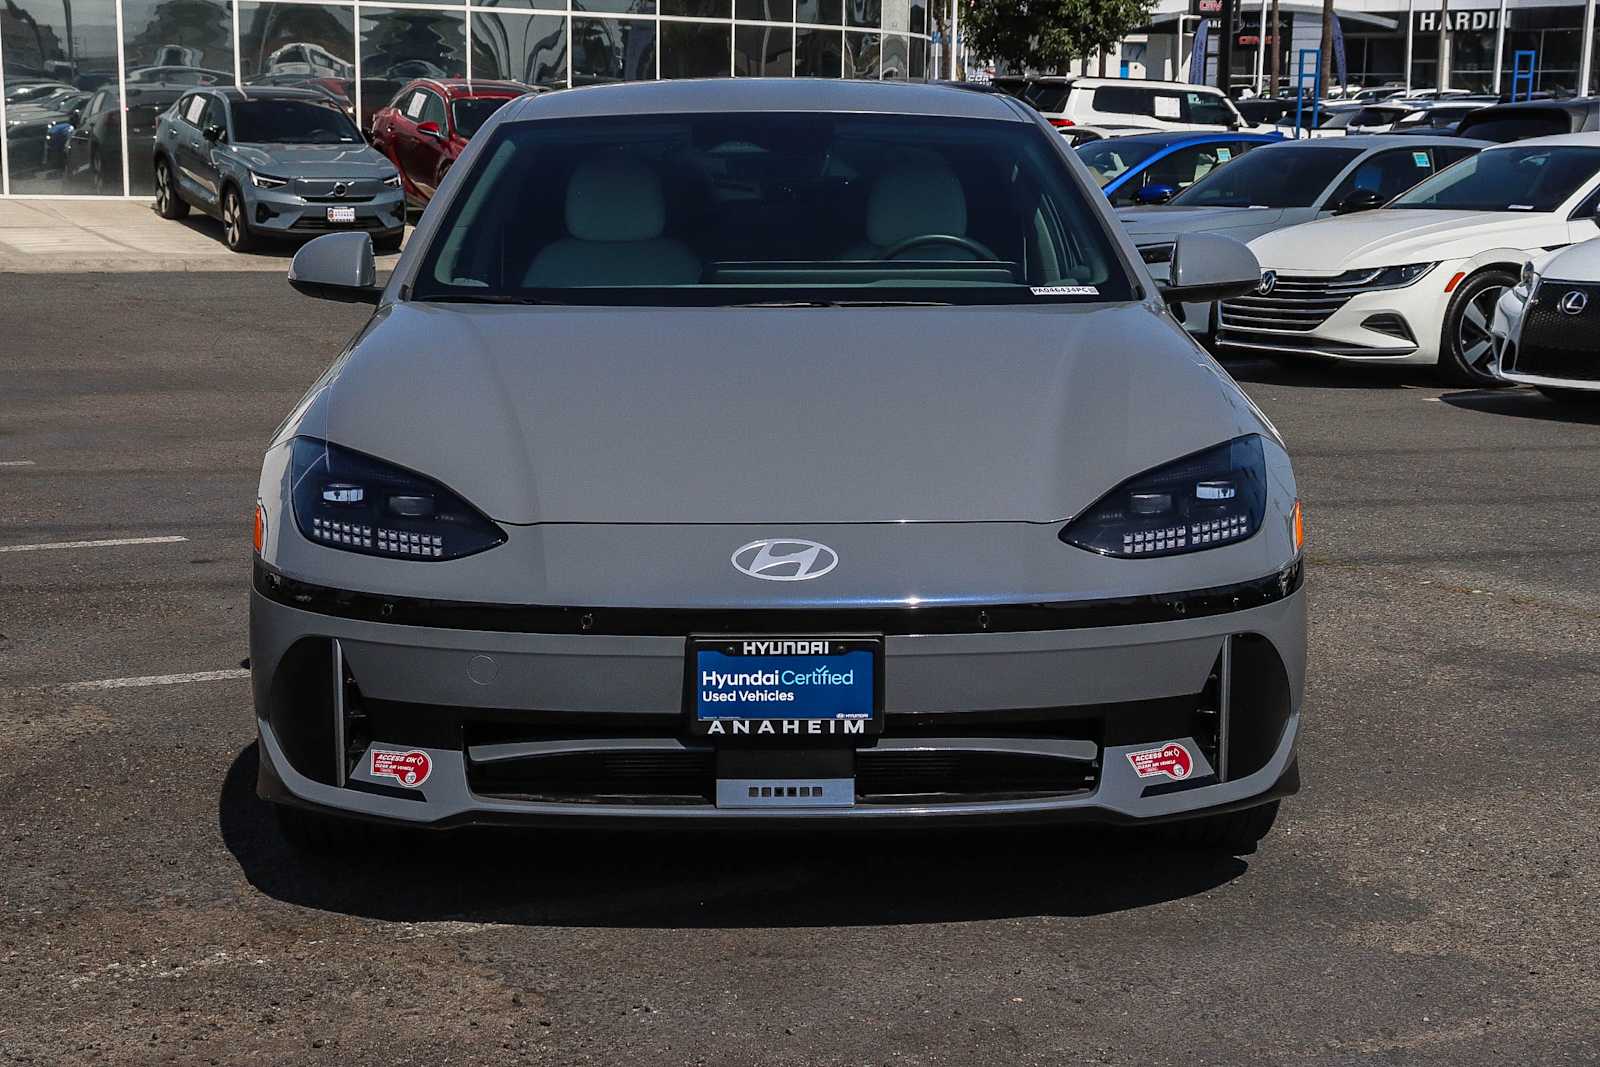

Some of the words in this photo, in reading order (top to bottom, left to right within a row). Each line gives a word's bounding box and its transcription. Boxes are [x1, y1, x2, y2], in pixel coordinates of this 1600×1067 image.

[1420, 10, 1512, 31] HARDIN
[743, 641, 829, 655] HYUNDAI
[702, 670, 779, 689] Hyundai
[781, 665, 854, 685] Certified
[702, 691, 737, 702] Used
[739, 690, 795, 702] Vehicles
[707, 720, 865, 734] ANAHEIM
[1135, 753, 1162, 761] ACCESS
